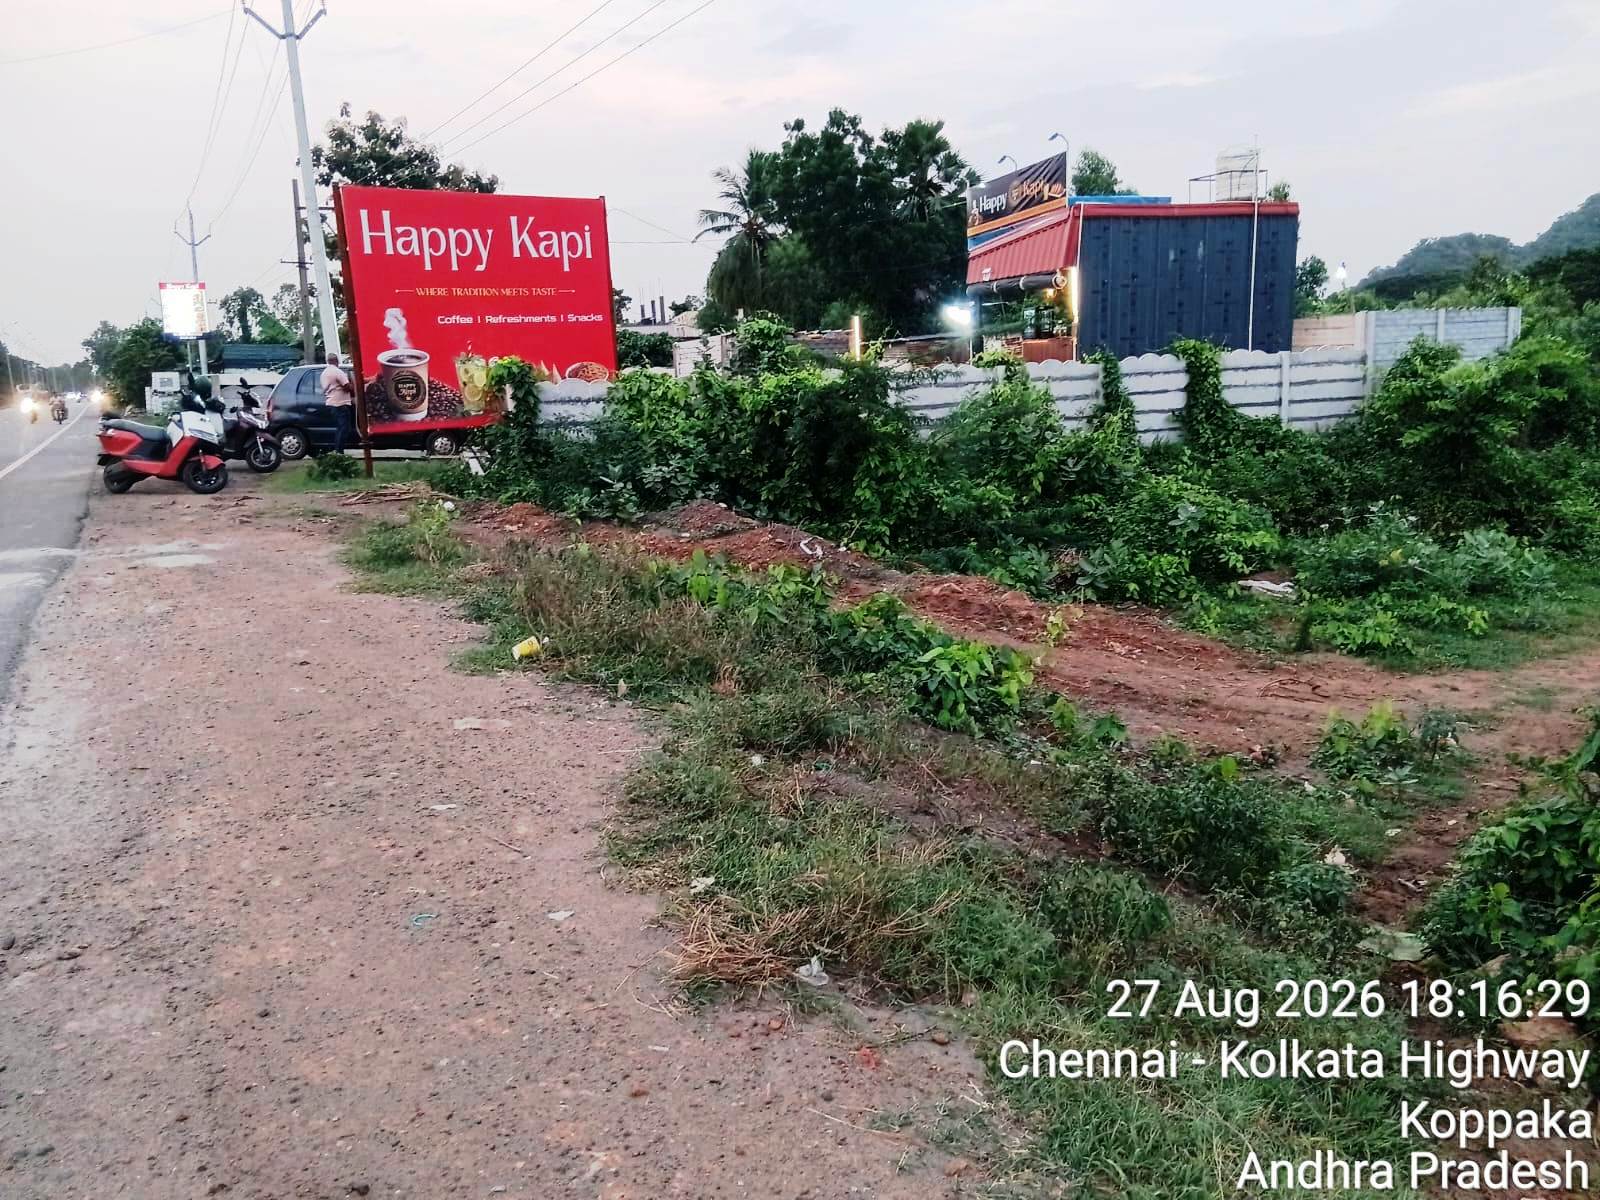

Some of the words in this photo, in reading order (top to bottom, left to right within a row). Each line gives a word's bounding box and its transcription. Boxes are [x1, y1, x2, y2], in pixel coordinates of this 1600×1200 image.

[979, 192, 1008, 213] Happy
[359, 208, 494, 272] Happy
[509, 215, 593, 272] Kapi
[415, 287, 449, 297] WHERE
[452, 287, 499, 297] TRADITION
[500, 287, 529, 297] MEETS
[531, 287, 557, 297] TASTE
[437, 314, 473, 325] Coffee
[485, 314, 557, 324] Refreshments
[567, 313, 604, 323] Snacks
